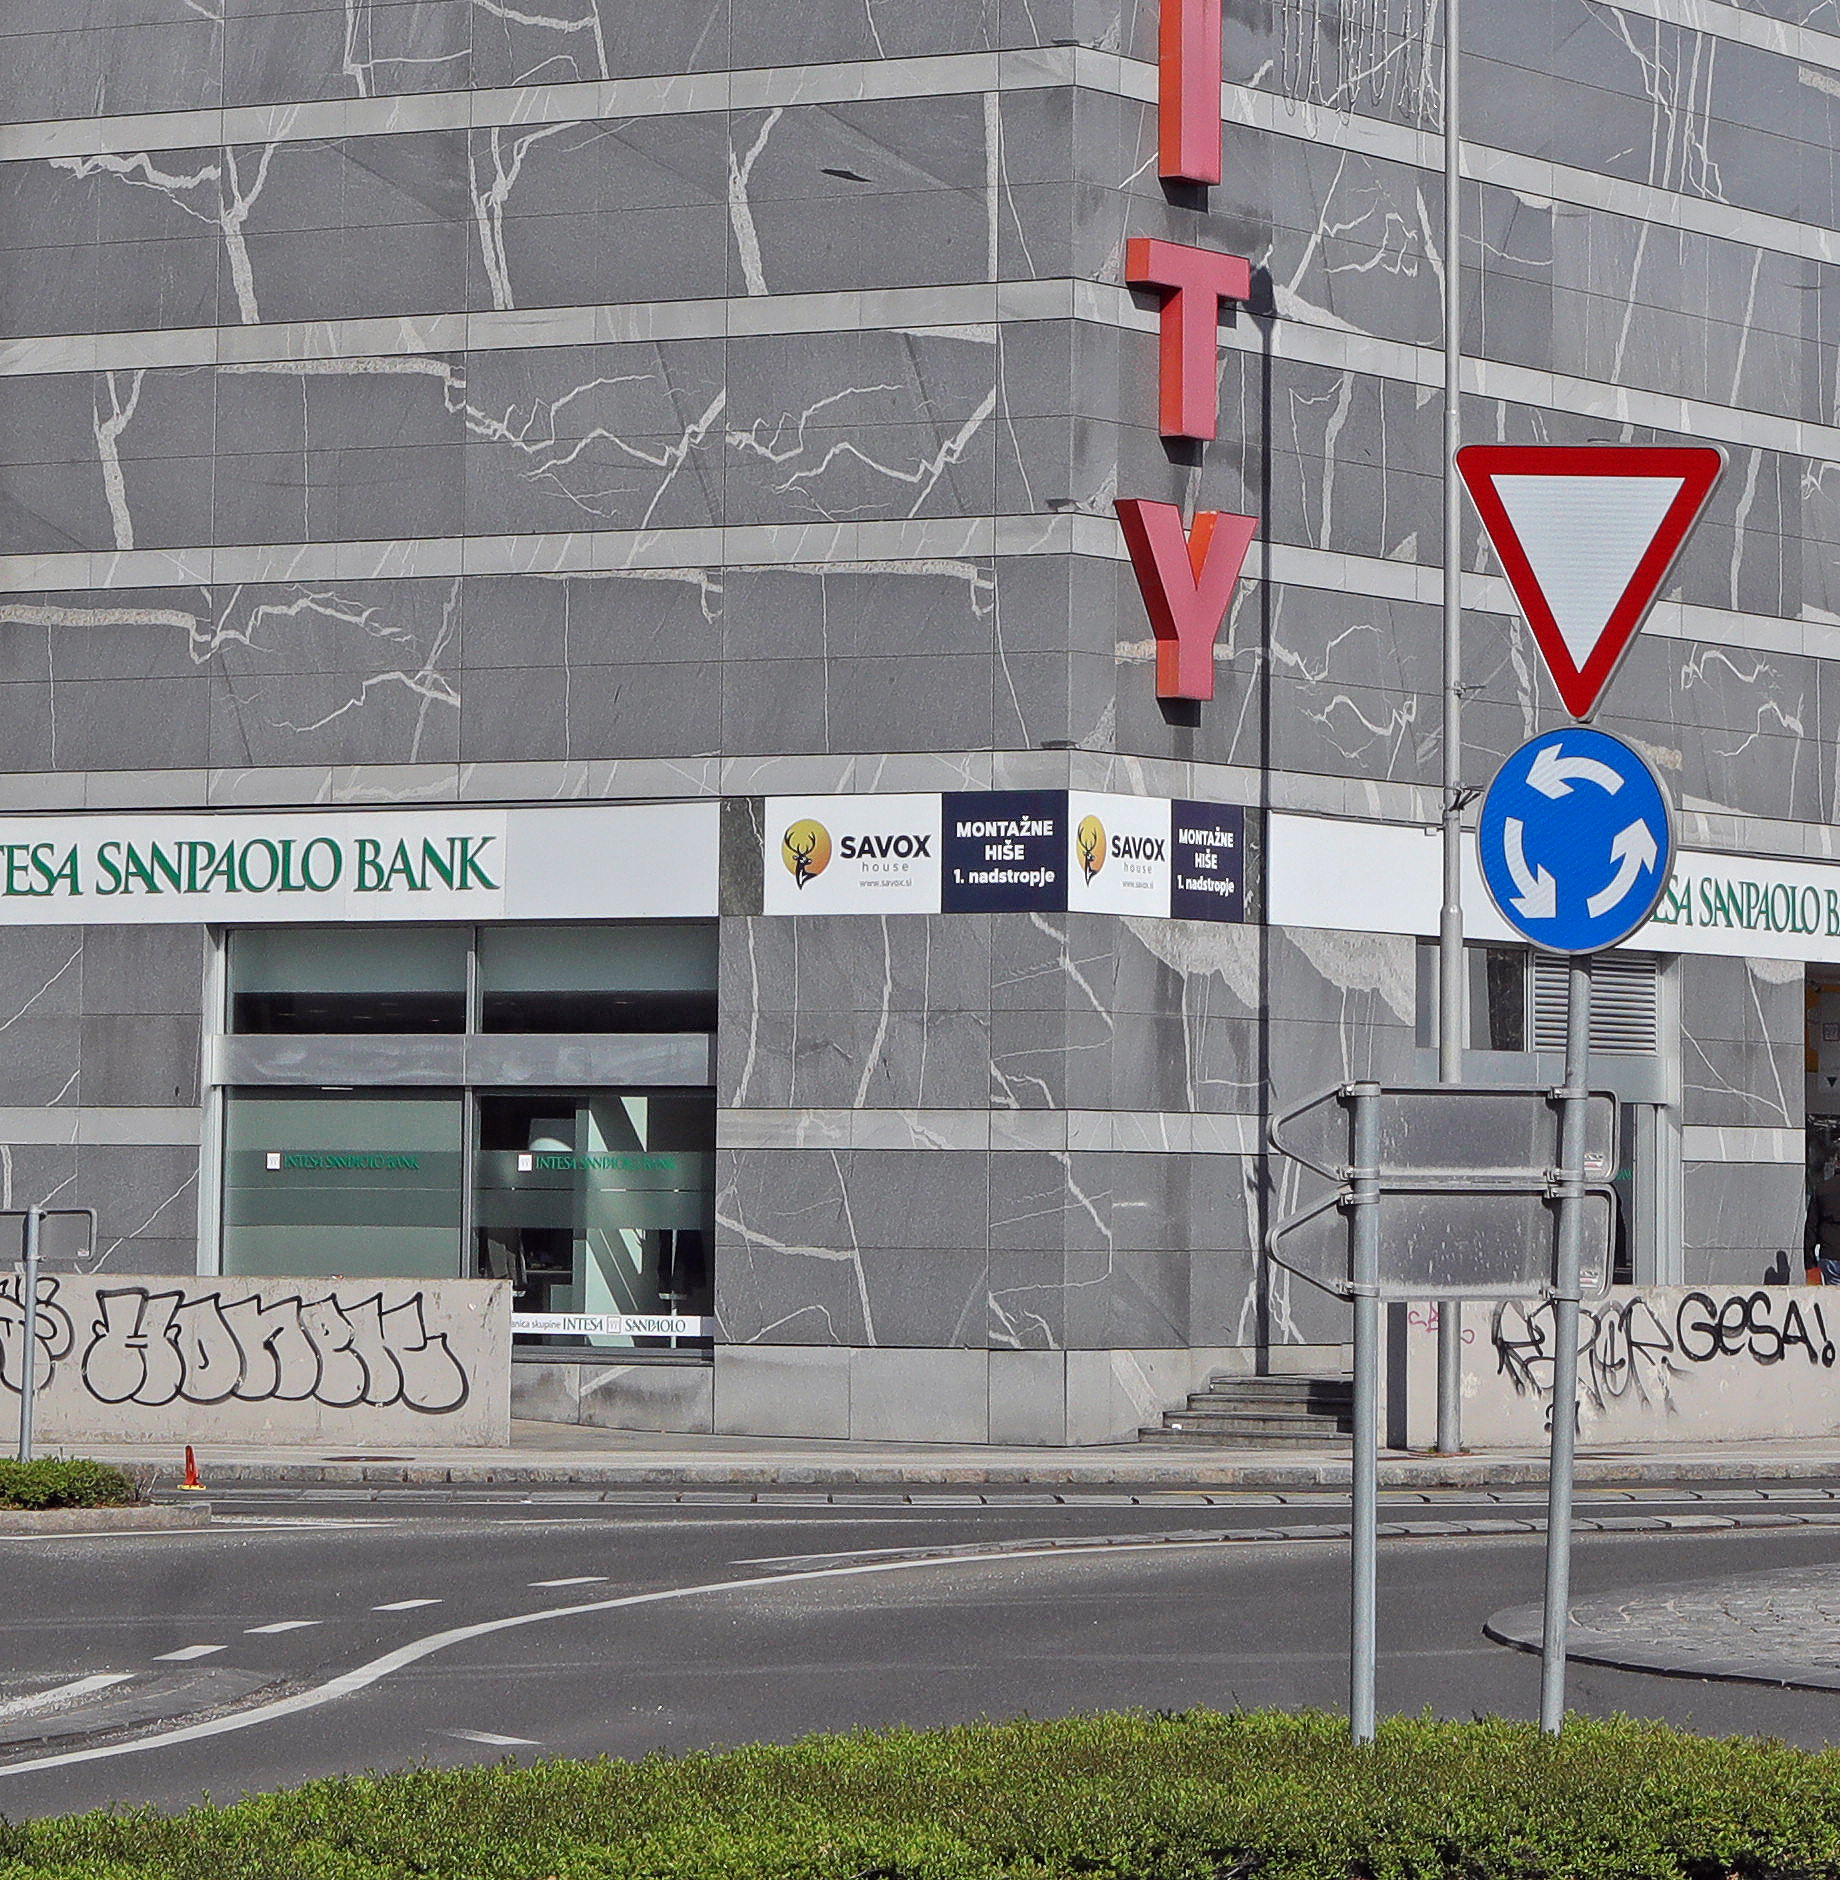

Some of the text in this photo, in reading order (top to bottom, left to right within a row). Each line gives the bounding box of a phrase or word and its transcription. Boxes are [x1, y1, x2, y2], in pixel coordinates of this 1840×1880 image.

[956, 815, 1053, 839] MONTAŽNE
[1178, 826, 1234, 850] MONTAŽNE
[840, 834, 932, 860] SAVOX
[984, 839, 1026, 861] HIŠE
[1111, 833, 1166, 863] SAVOX
[95, 837, 343, 895] SANPAOLO
[354, 835, 501, 893] BANK
[861, 861, 910, 873] house
[1123, 861, 1152, 875] house
[1194, 848, 1218, 870] HIŠE
[859, 878, 912, 889] www.savox.si
[954, 867, 1055, 888] 1. nadstropje
[1185, 875, 1235, 895] nadstropje
[1699, 876, 1820, 934] SANPAOLO
[563, 1317, 603, 1331] INTESA
[625, 1319, 686, 1333] SANPAOLO
